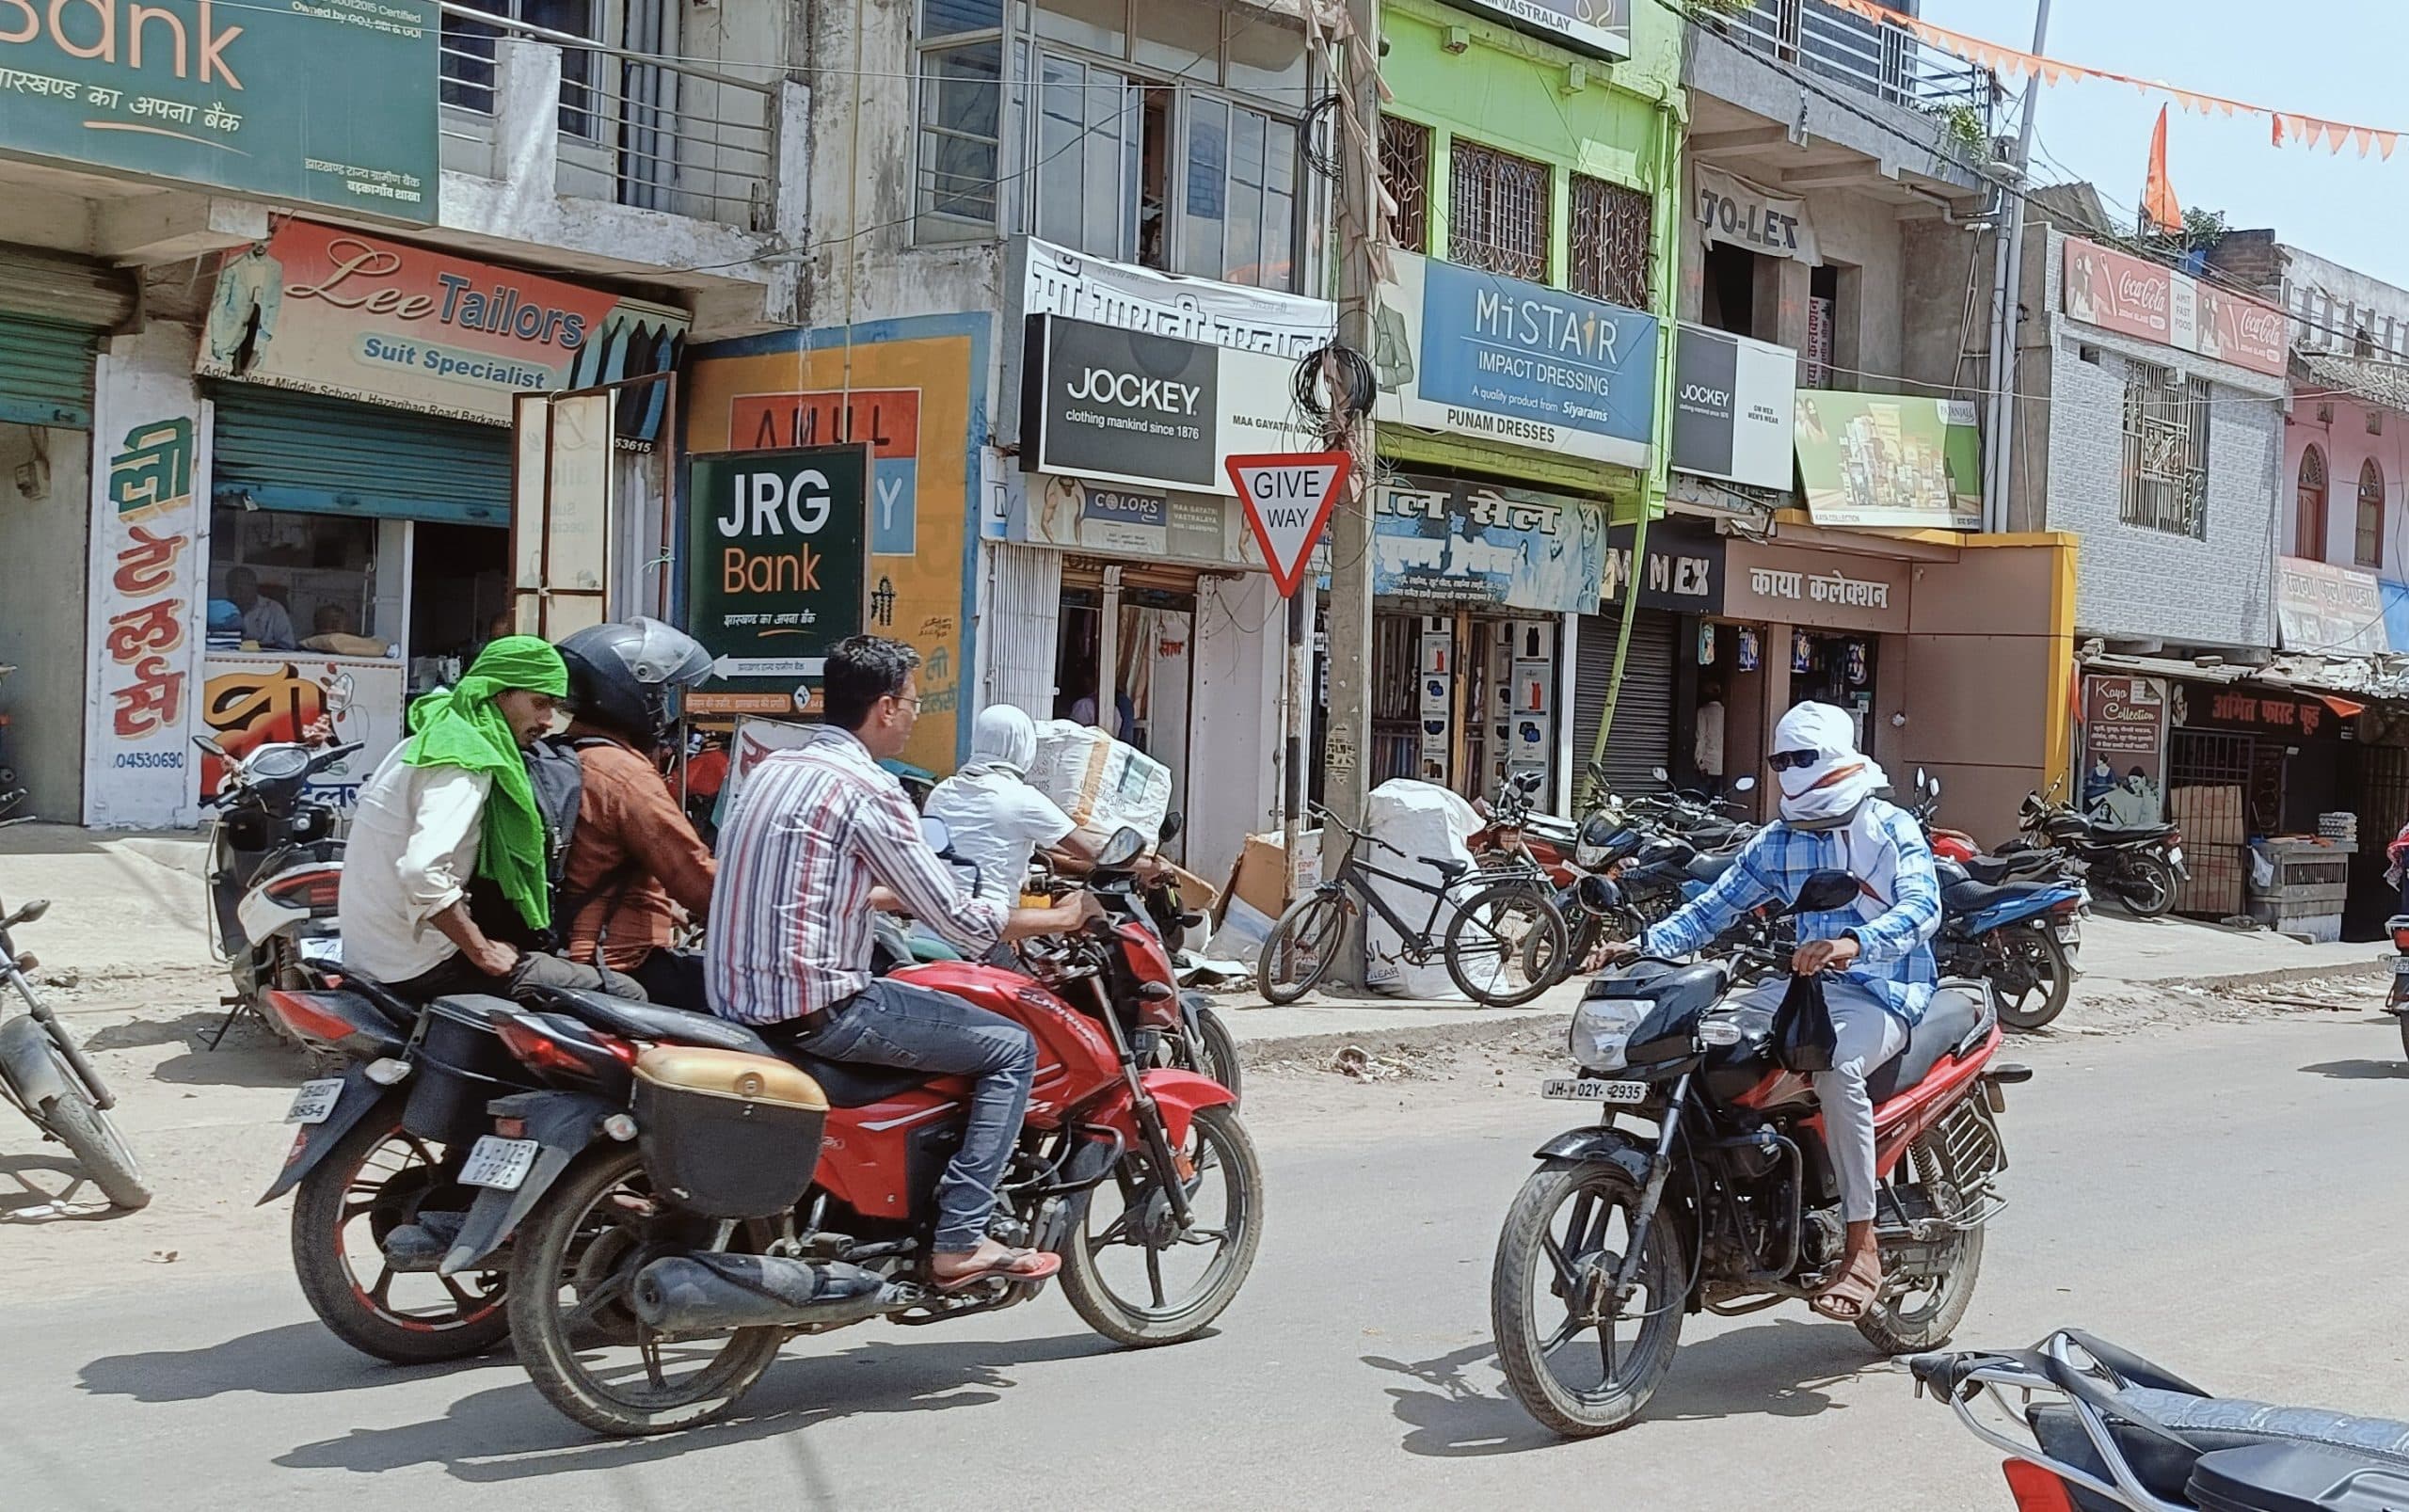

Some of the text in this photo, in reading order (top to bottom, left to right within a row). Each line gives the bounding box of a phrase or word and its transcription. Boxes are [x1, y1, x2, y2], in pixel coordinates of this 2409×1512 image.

[292, 1, 330, 18] Owned
[332, 9, 346, 24] by
[378, 6, 422, 24] Certified
[0, 67, 242, 133] ारखण्ड का अपना बैंक
[1700, 188, 1798, 249] TO-LET
[285, 239, 586, 349] Lee Tailors
[2119, 270, 2167, 312] Coca-Cola
[2241, 308, 2282, 346] Coca-Cola
[363, 337, 544, 391] Suit Specialist
[1478, 350, 1609, 397] IMPACT DRESSING
[242, 373, 271, 386] Near
[275, 376, 317, 392] Middle
[320, 385, 362, 402] School
[428, 405, 459, 420] Road
[1066, 367, 1201, 417] JOCKEY
[1471, 384, 1479, 396] A
[1480, 387, 1508, 405] quality
[1508, 393, 1539, 409] product
[1540, 398, 1558, 412] from
[1680, 383, 1730, 407] JOCKEY
[1065, 408, 1200, 440] clothing mankind since 1876
[1233, 415, 1253, 427] MAA
[1255, 419, 1294, 433] GAYATRI
[1446, 408, 1555, 445] PUNAM DRESSES
[614, 438, 652, 453] 53615
[718, 469, 831, 537] JRG
[1094, 492, 1159, 514] COLORS
[1254, 470, 1319, 500] GIVE
[1268, 508, 1310, 529] WAY
[1467, 488, 1561, 534] सेल
[723, 542, 822, 594] Bank
[1604, 548, 1710, 597] M MEX
[1749, 567, 1890, 609] काया कलेक्शन
[760, 613, 773, 625] का
[801, 608, 817, 624] बैंक
[2095, 679, 2128, 702] Kaya
[2103, 702, 2155, 722] Collection
[2212, 691, 2257, 723] अमित
[2261, 699, 2295, 725] फास्ट
[2299, 704, 2321, 735] फूड
[113, 751, 184, 769] 04530690
[1610, 1084, 1641, 1100] 2935
